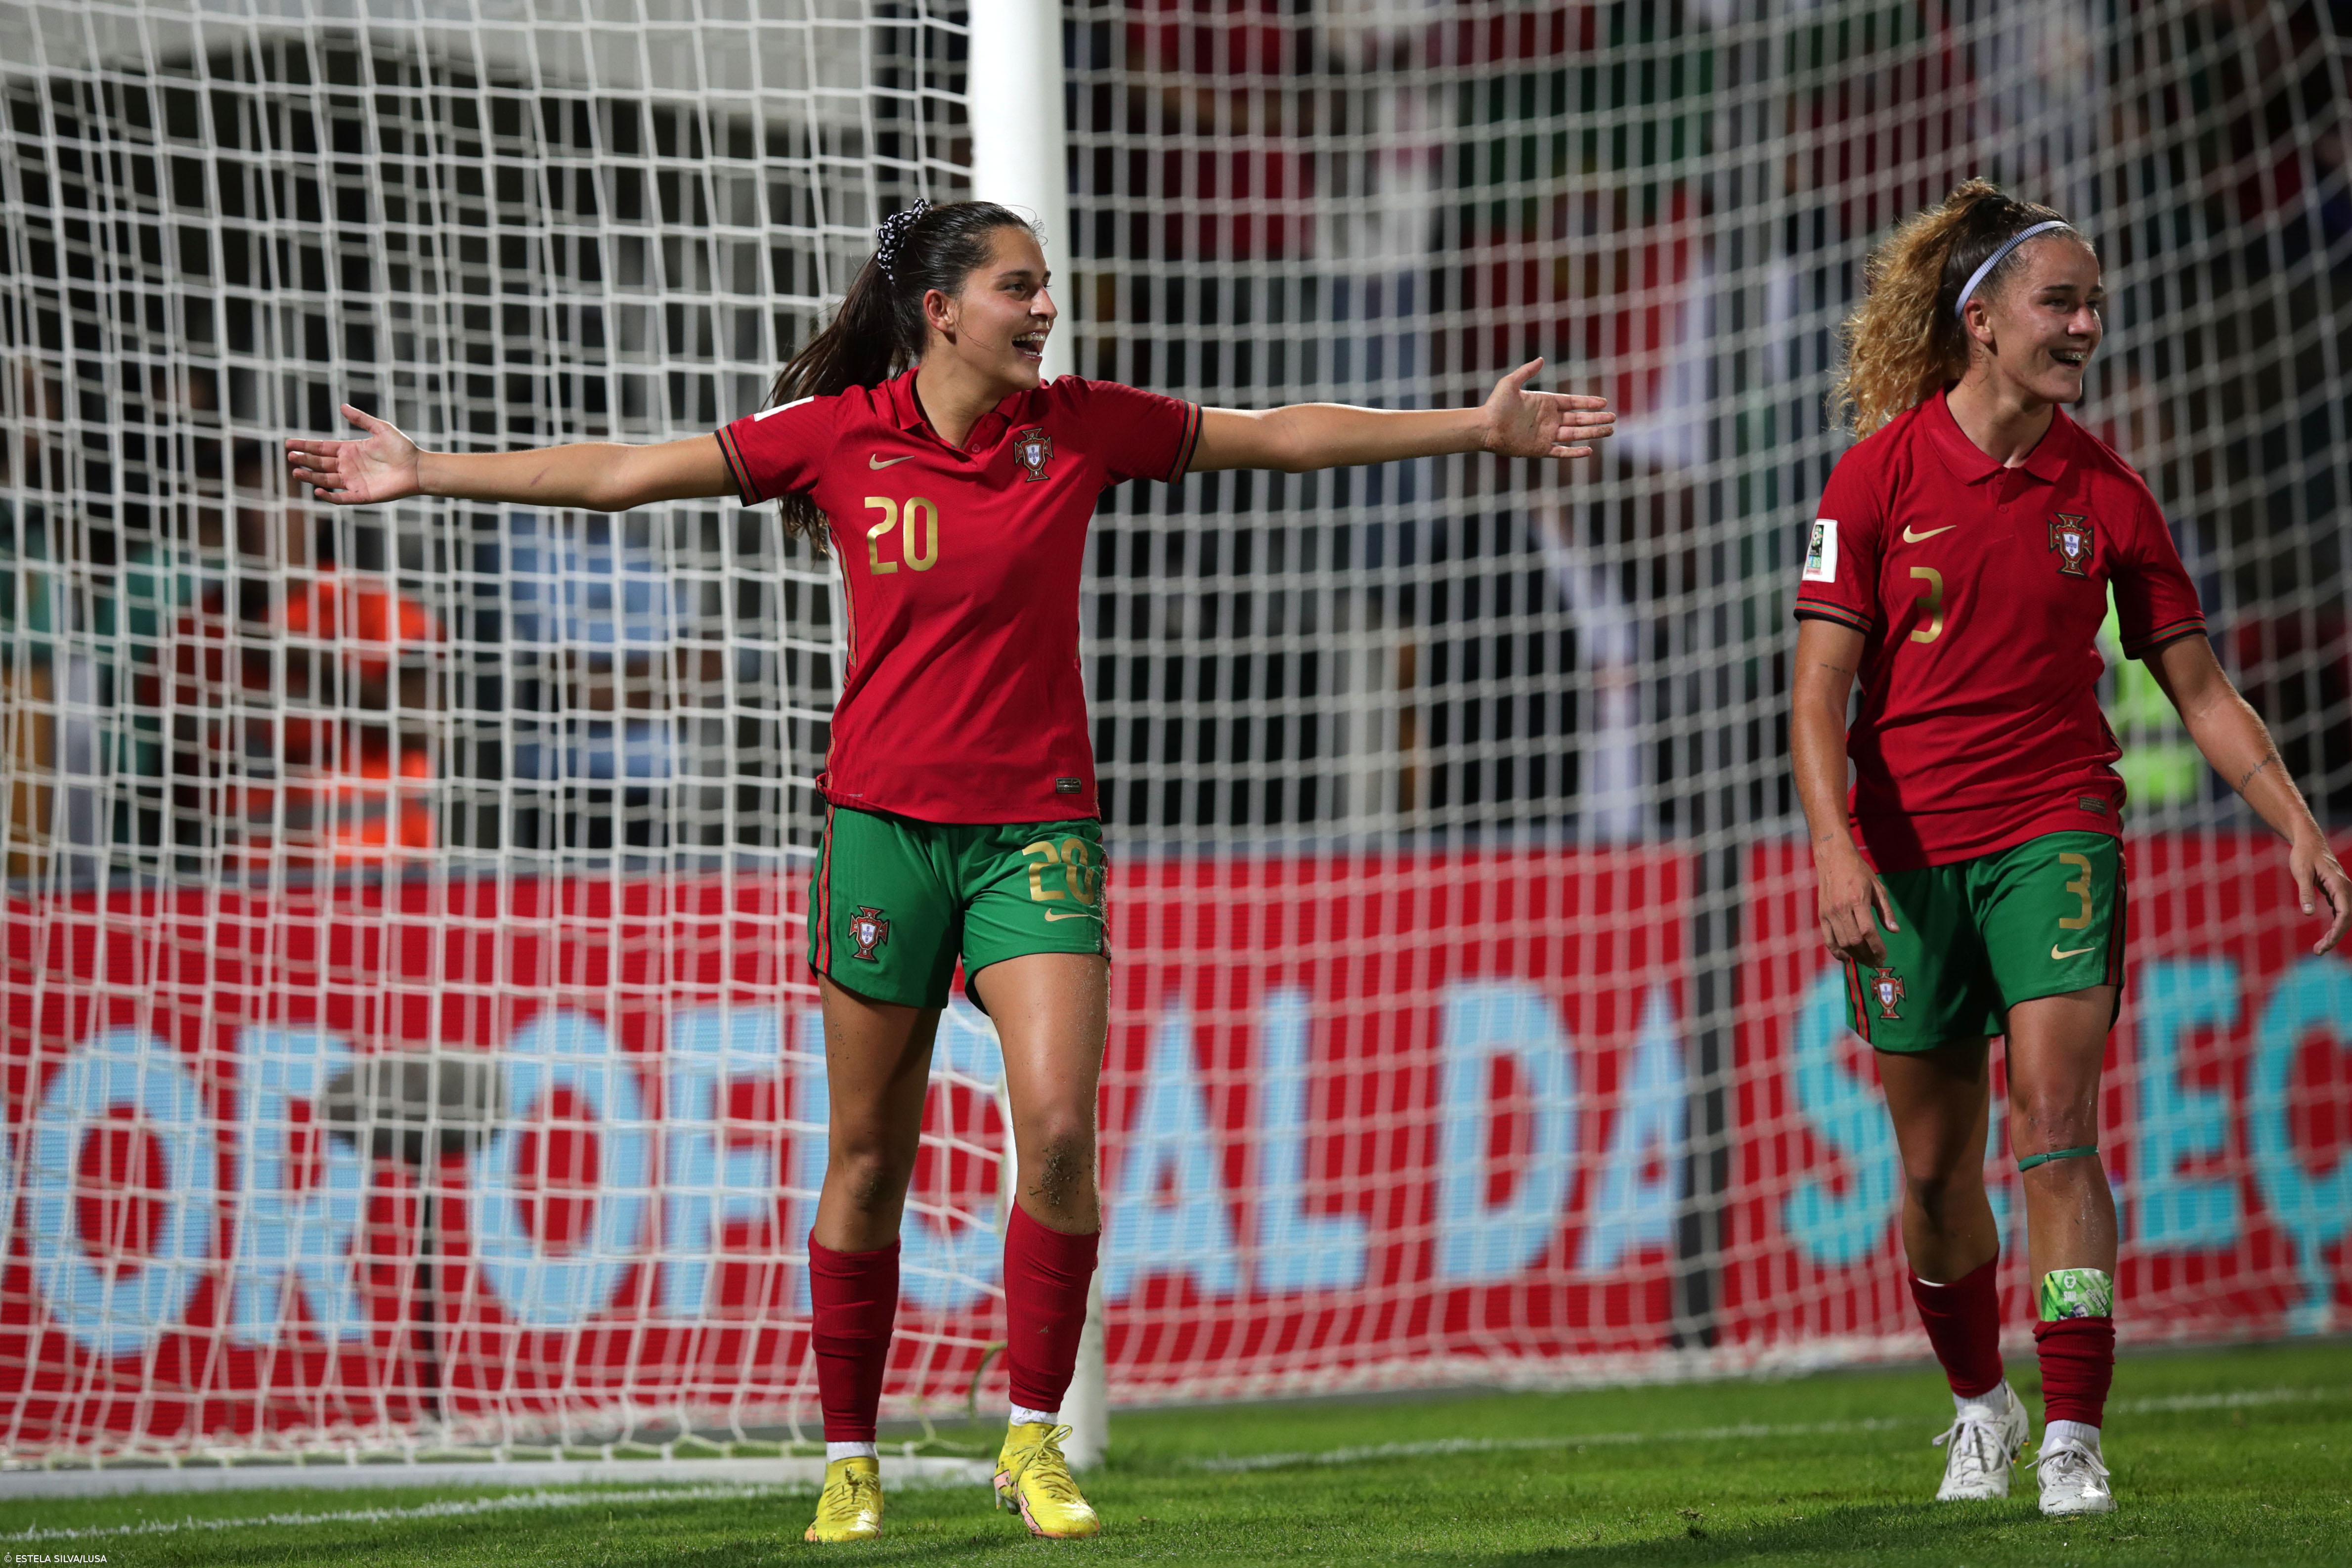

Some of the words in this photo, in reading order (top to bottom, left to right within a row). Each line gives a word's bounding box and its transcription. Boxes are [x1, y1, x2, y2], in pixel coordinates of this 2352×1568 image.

[865, 497, 938, 575] 20
[1910, 566, 1943, 644] 3
[2059, 853, 2092, 929] 3
[0, 1023, 368, 1357] OR
[1436, 978, 1688, 1279] DA
